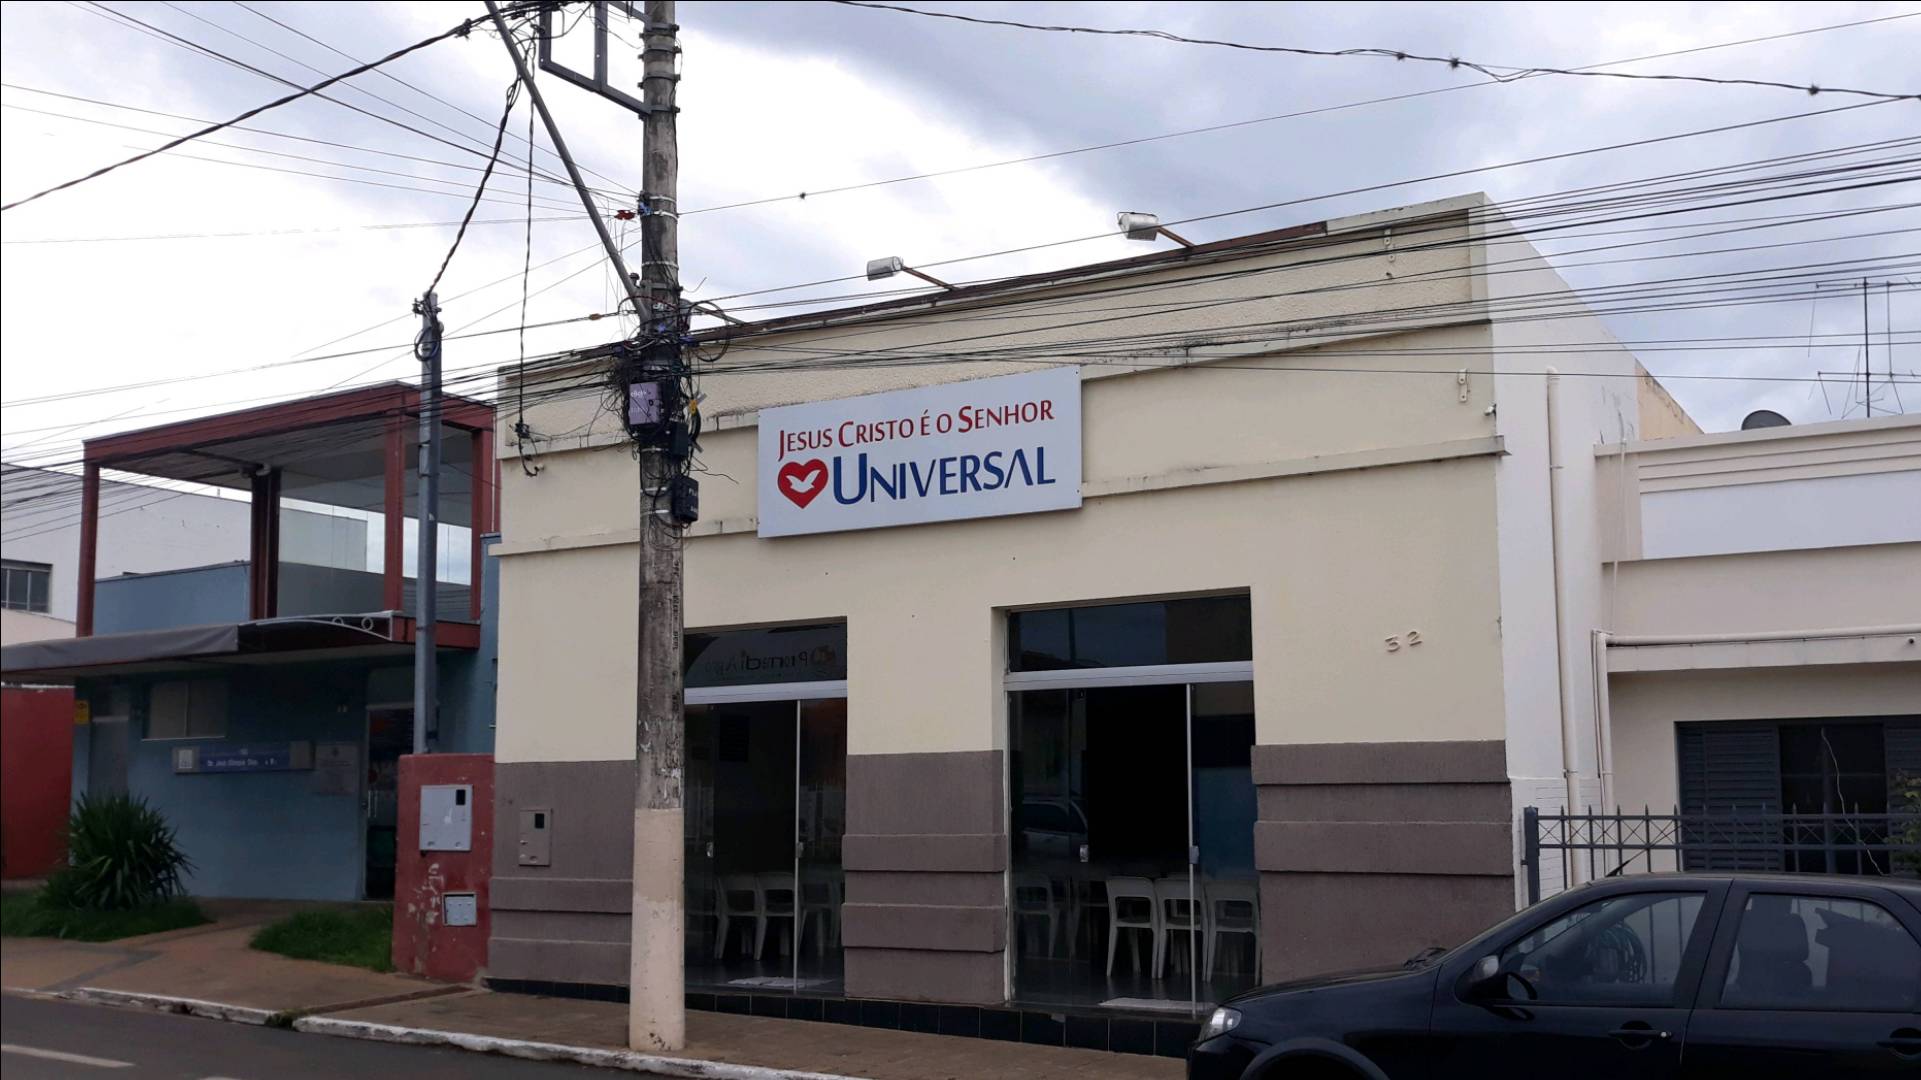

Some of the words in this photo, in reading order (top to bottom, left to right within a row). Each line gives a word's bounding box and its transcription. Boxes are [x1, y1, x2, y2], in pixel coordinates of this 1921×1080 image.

[778, 428, 833, 462] JESUS
[838, 418, 914, 447] CRISTO
[920, 410, 930, 436] É
[936, 413, 952, 434] O
[958, 400, 1054, 433] SENHOR
[833, 446, 1056, 505] UNIVERSAL
